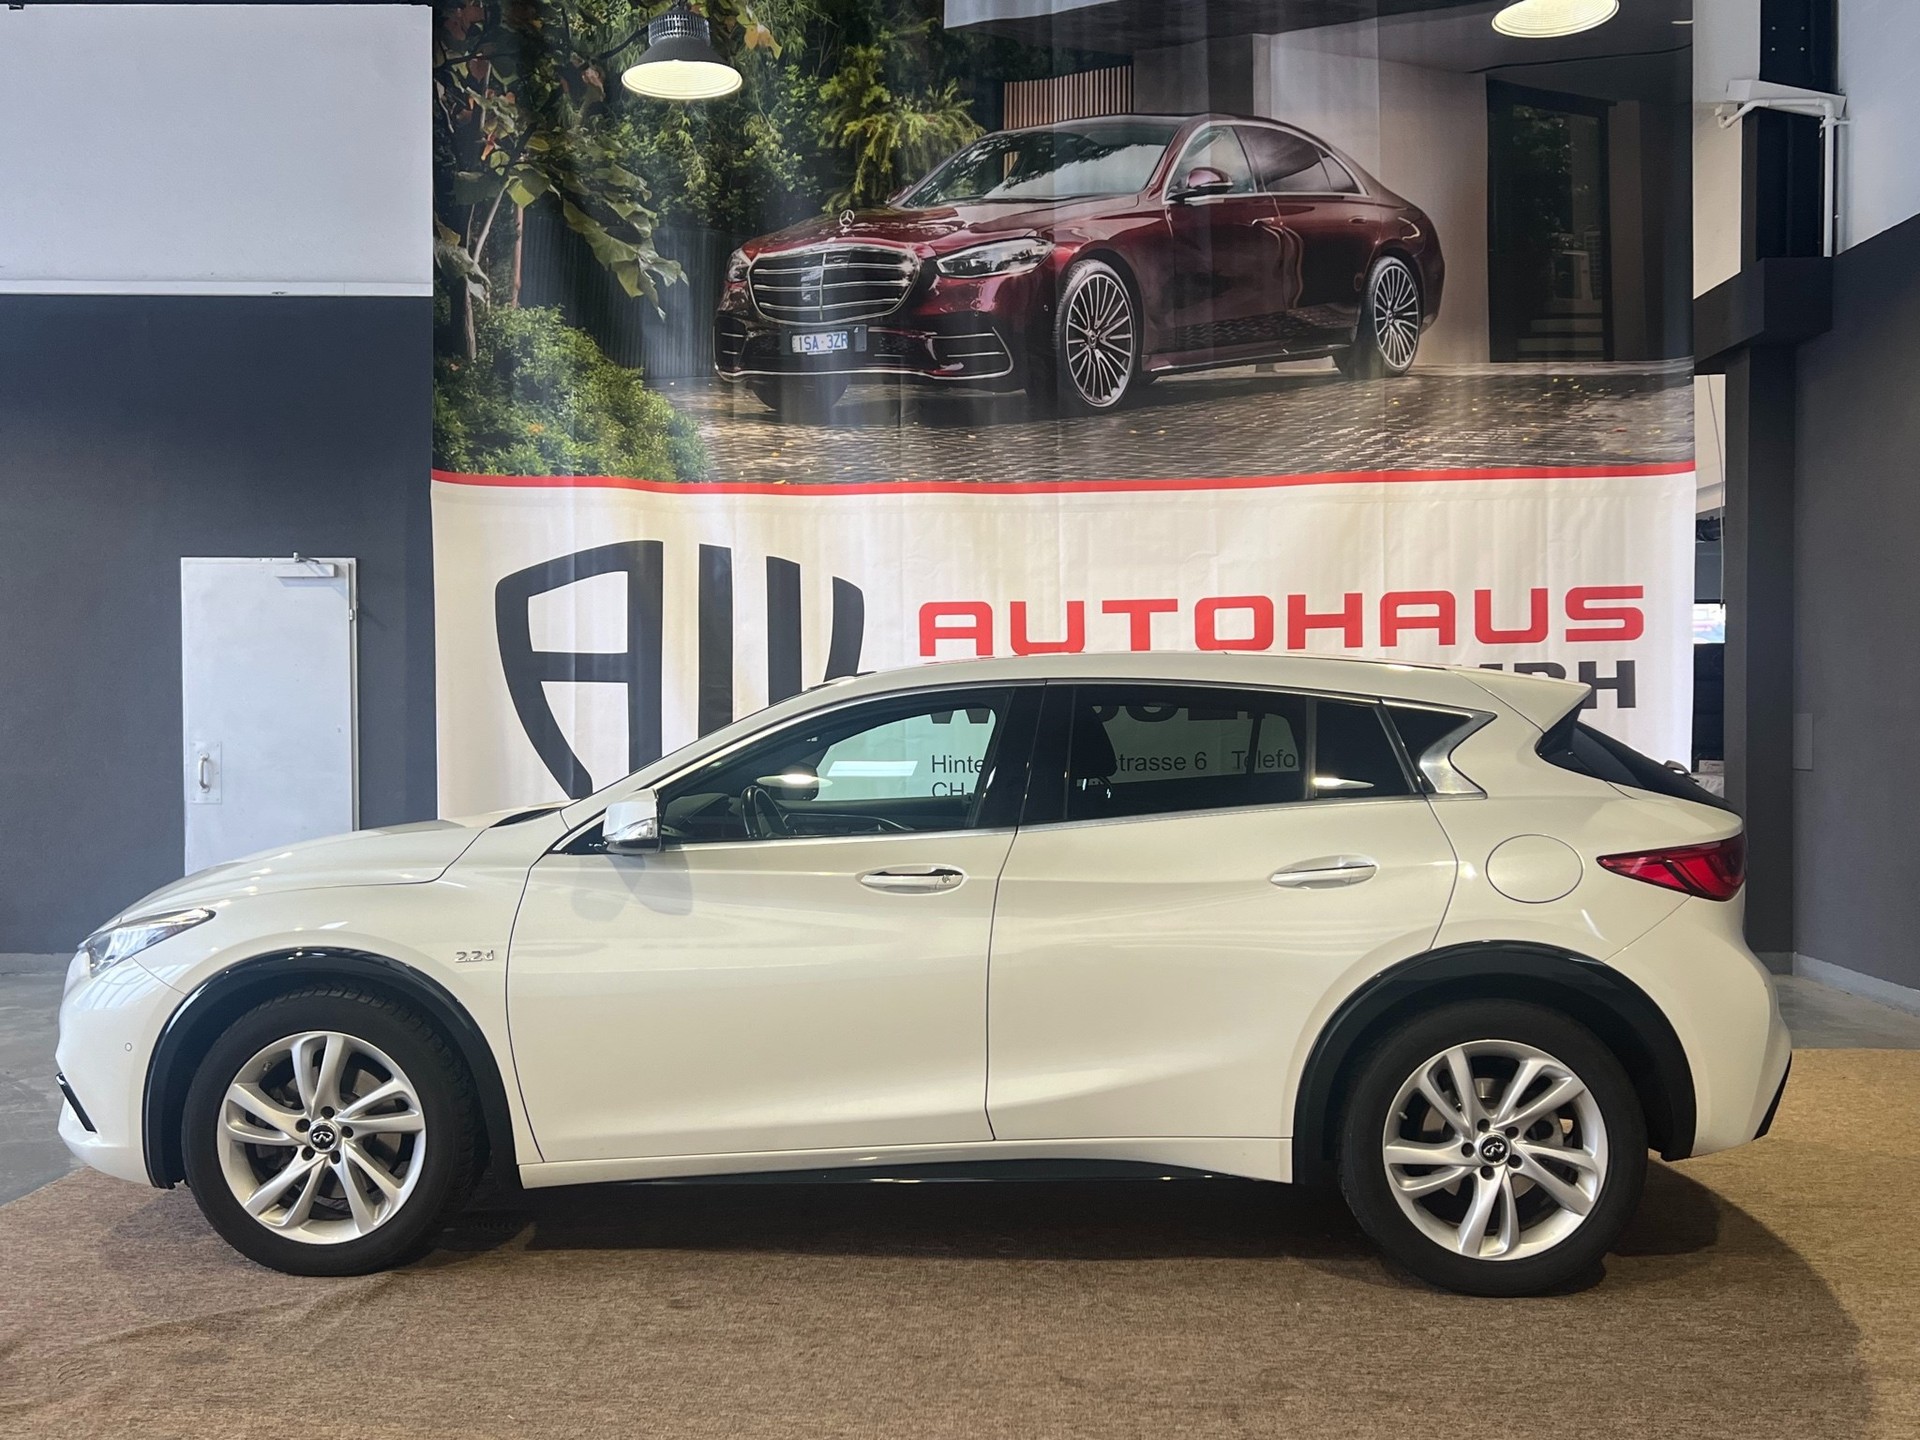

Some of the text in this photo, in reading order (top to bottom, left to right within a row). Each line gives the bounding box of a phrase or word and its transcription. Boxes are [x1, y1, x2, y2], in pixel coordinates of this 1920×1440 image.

[918, 585, 1645, 656] AUTOHAUS
[932, 750, 1296, 773] Hinte trasse 6 Tlefo
